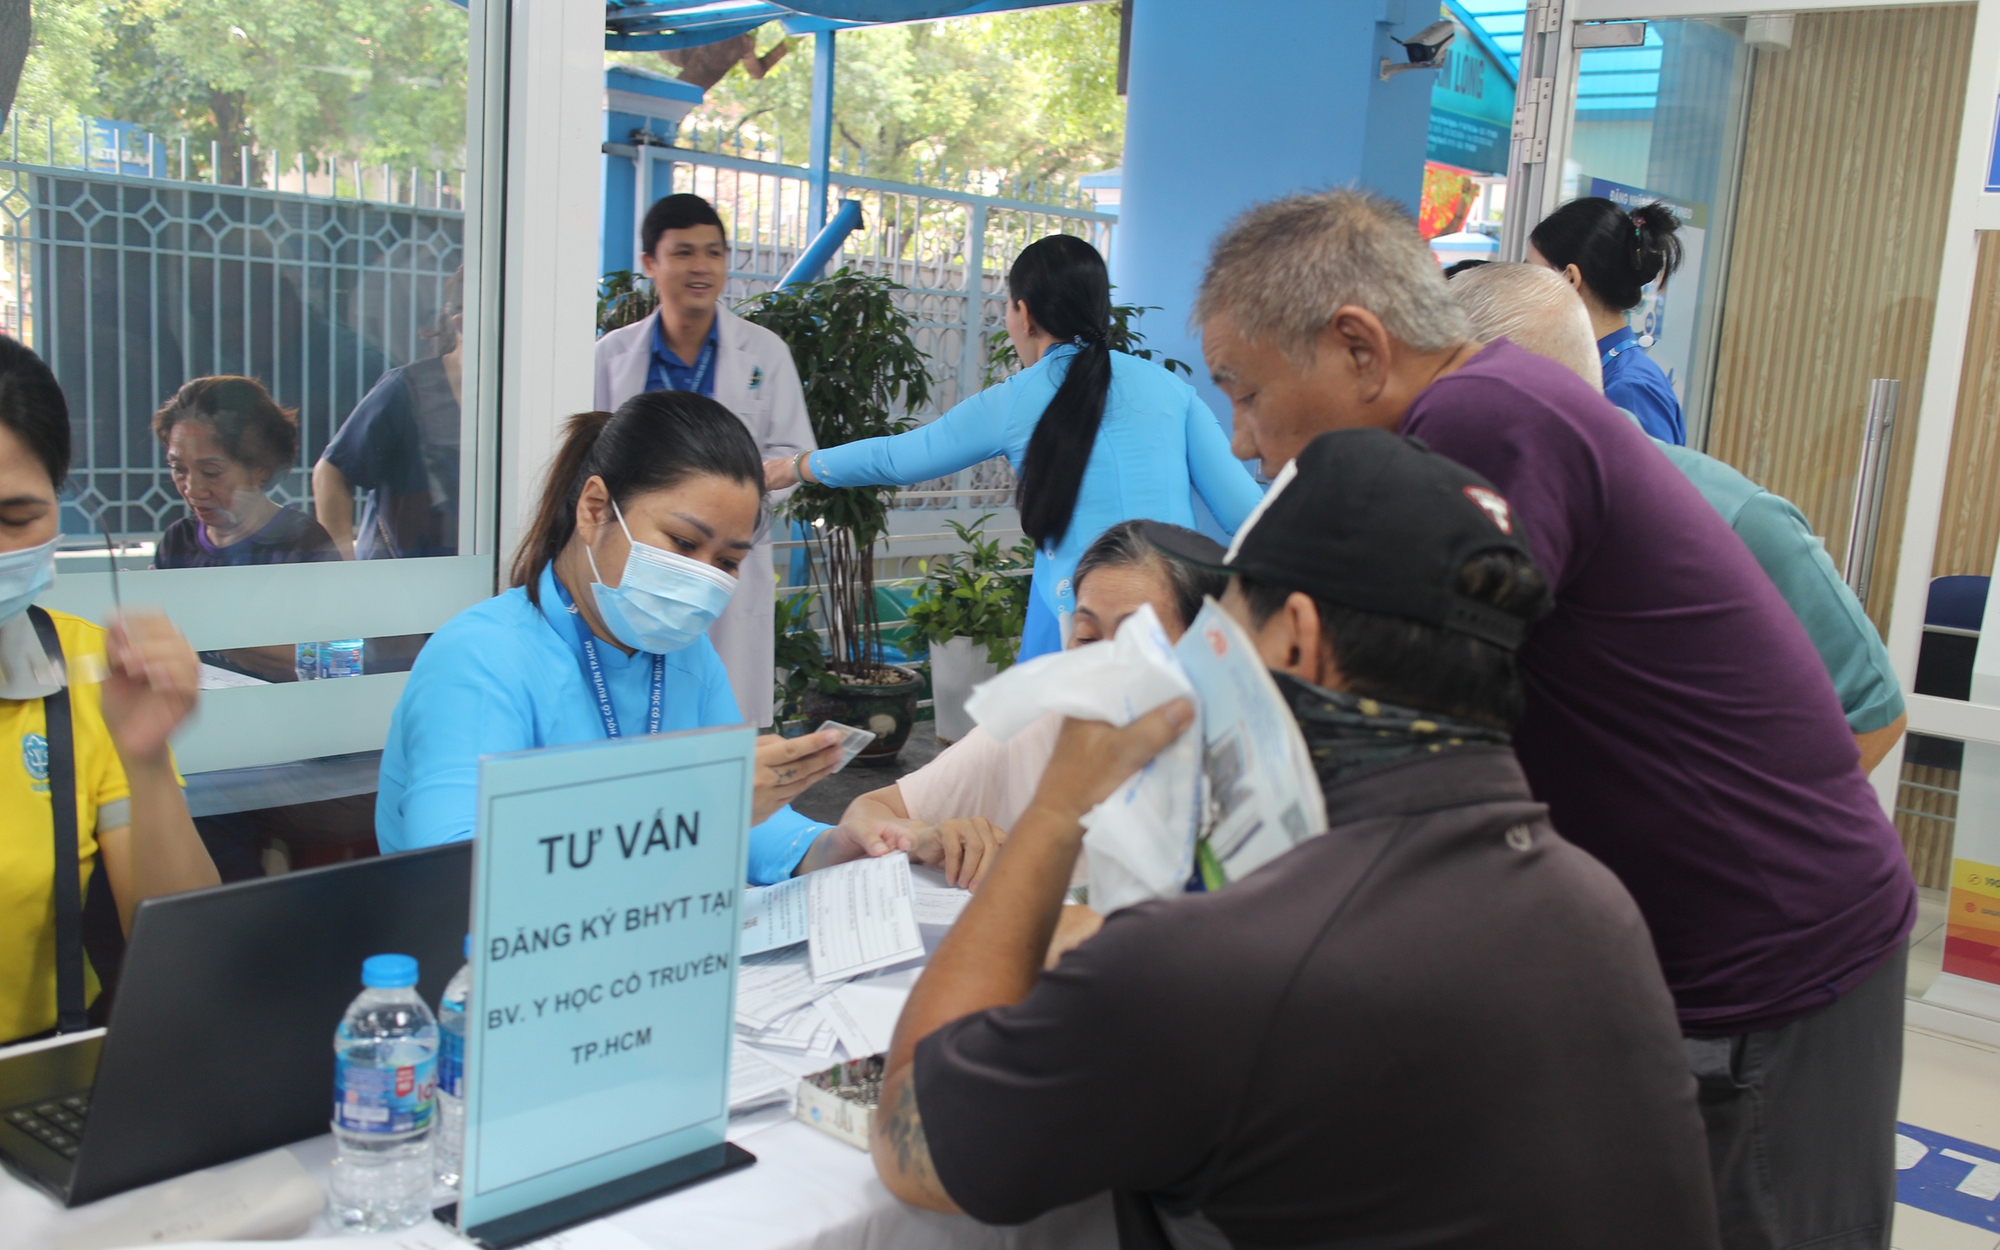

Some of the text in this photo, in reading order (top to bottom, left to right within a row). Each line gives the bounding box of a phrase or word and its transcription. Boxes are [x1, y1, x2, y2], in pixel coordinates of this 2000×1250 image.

[538, 807, 700, 875] TƯ VẤN
[489, 922, 572, 963] ĐĂNG
[581, 906, 616, 941] KÝ
[625, 895, 692, 932] BHYT
[700, 888, 734, 917] TẠI
[487, 1004, 526, 1031] BV.
[533, 996, 549, 1019] Y
[553, 984, 604, 1013] HỌC
[648, 952, 730, 989] TRUYỀN
[571, 1025, 652, 1066] TP.HCM
